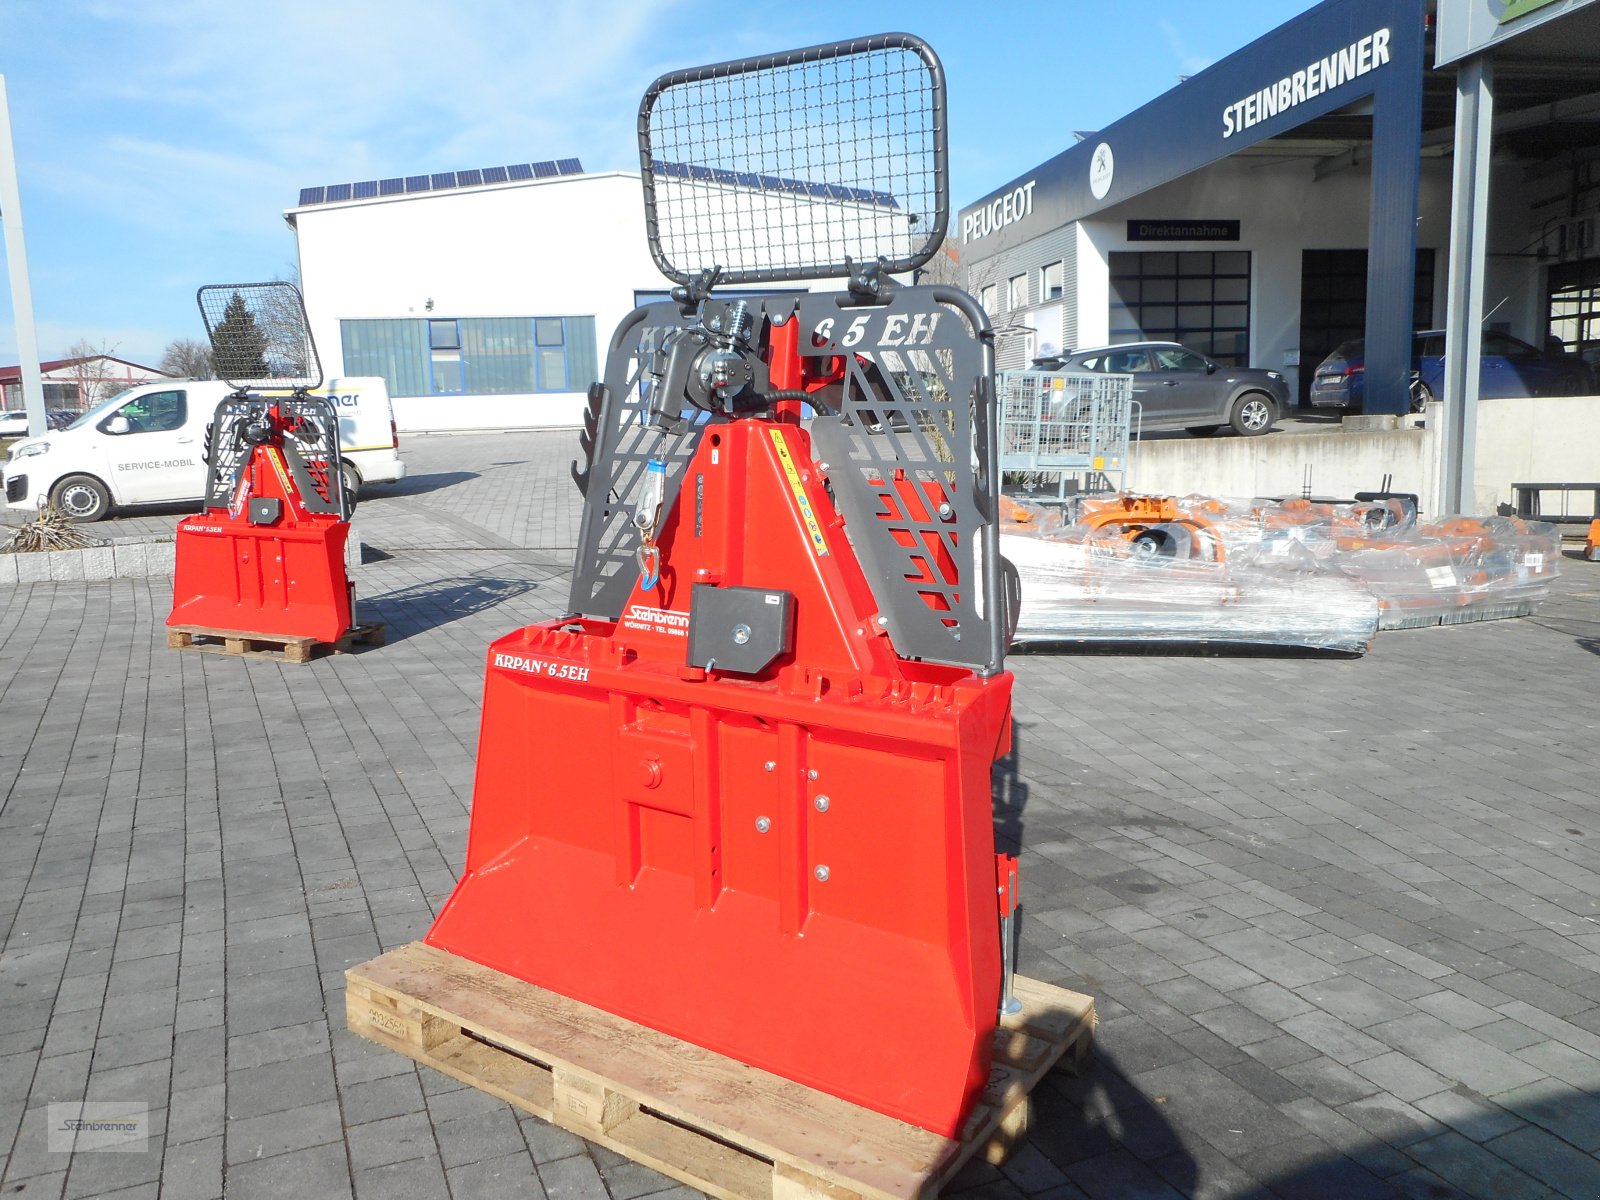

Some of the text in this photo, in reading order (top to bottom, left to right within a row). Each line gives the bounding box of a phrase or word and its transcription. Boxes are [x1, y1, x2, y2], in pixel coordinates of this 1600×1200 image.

[1222, 27, 1391, 139] STEINBRENNER
[963, 180, 1036, 245] PEUGEOT
[1139, 225, 1229, 236] Direktannahme
[876, 312, 943, 348] EH
[118, 459, 195, 471] SERVICE-MOBIL
[624, 604, 690, 627] Steinbrenn
[548, 663, 590, 682] 6.5EH
